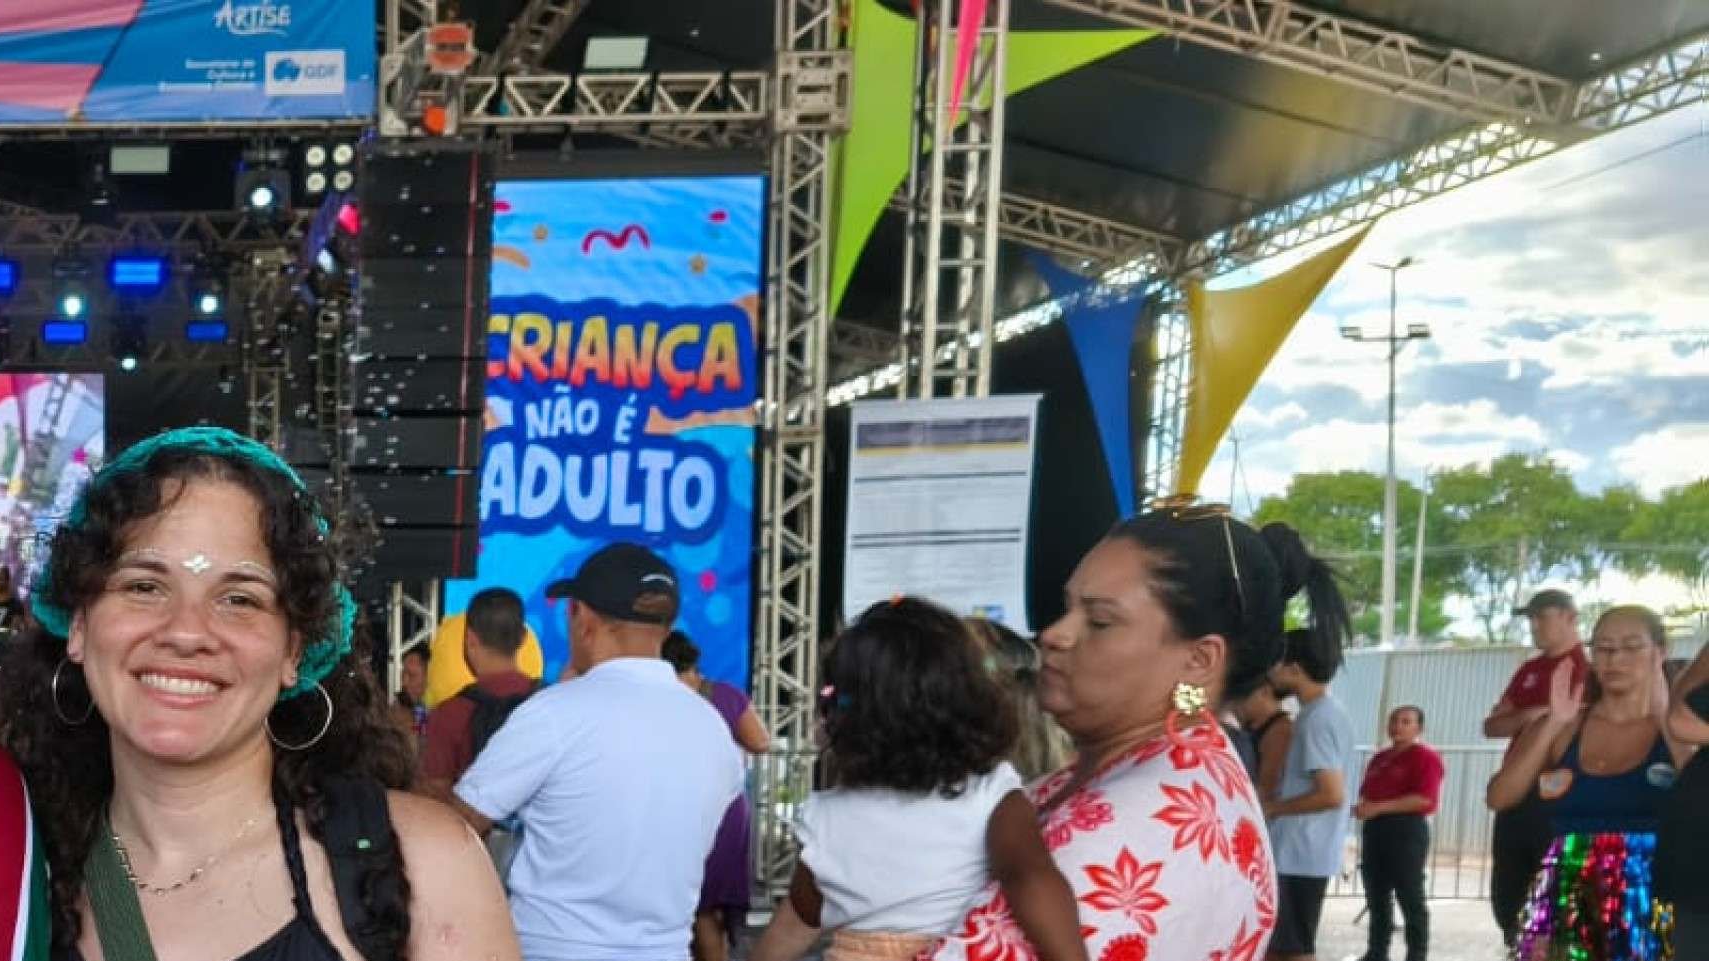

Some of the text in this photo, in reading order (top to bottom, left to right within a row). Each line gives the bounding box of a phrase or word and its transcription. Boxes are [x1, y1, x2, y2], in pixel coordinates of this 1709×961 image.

[524, 384, 638, 443] NÃO É
[479, 441, 717, 533] ADULTO
